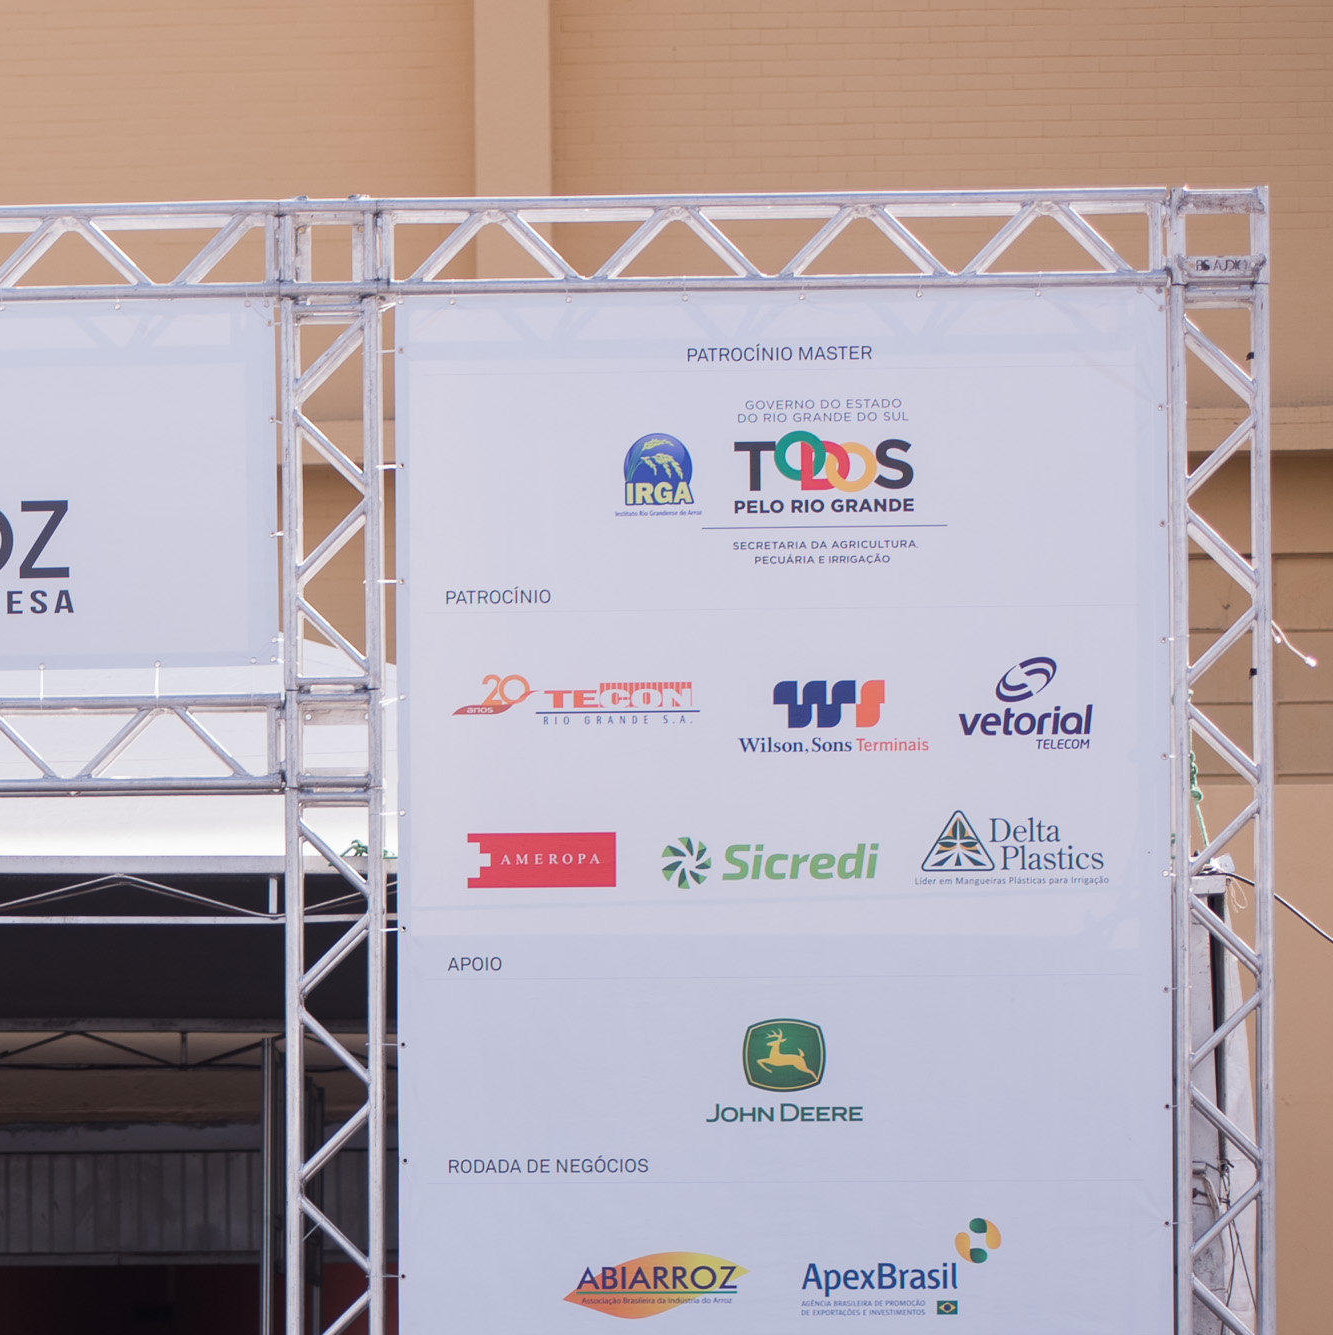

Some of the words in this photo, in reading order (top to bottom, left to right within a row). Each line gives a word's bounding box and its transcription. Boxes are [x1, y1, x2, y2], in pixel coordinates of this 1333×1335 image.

[686, 343, 794, 363] PATROCÍNIO
[798, 345, 873, 361] MASTER
[744, 399, 816, 411] GOVERNO
[820, 398, 842, 410] DO
[845, 398, 903, 409] ESTADO
[737, 412, 759, 424] DO
[762, 412, 788, 424] RIO
[792, 411, 852, 423] GRANDE
[856, 411, 878, 422] DO
[883, 410, 910, 422] SUL
[734, 430, 914, 493] TODOS
[624, 479, 694, 505] IRGA
[733, 499, 785, 515] PELO
[790, 498, 826, 514] RIO
[830, 497, 915, 514] GRANDE
[732, 540, 808, 551] SECRETARIA
[810, 540, 828, 550] DA
[754, 553, 816, 565] PECUÁRIA
[818, 555, 826, 565] E
[828, 552, 891, 565] IRRIGAÇÃO
[445, 585, 552, 605] PATROCÍNIO
[543, 682, 693, 709] TECON
[466, 706, 495, 714] anos
[542, 715, 571, 726] RIO
[583, 714, 649, 726] GRANDE
[958, 703, 1094, 737] vetorial
[855, 737, 930, 752] Terminais
[1035, 738, 1091, 750] TELECOM
[988, 816, 1062, 843] Delta
[499, 852, 601, 866] AMEROPA
[721, 842, 880, 881] Sicredi
[1000, 844, 1105, 871] Plastics
[938, 878, 954, 886] em
[955, 876, 1007, 887] Mangueiras
[1008, 875, 1047, 885] Plásticas
[1048, 877, 1069, 886] para
[447, 956, 503, 972] APOIO
[705, 1103, 775, 1123] JOHN
[779, 1102, 864, 1123] DEERE
[448, 1158, 522, 1174] RODADA
[526, 1158, 551, 1174] DE
[556, 1154, 650, 1174] NEGÓCIOS
[576, 1265, 738, 1290] ABIARROZ
[801, 1262, 958, 1298] ApexBrasil
[873, 1299, 883, 1307] DE
[800, 1309, 811, 1317] DE
